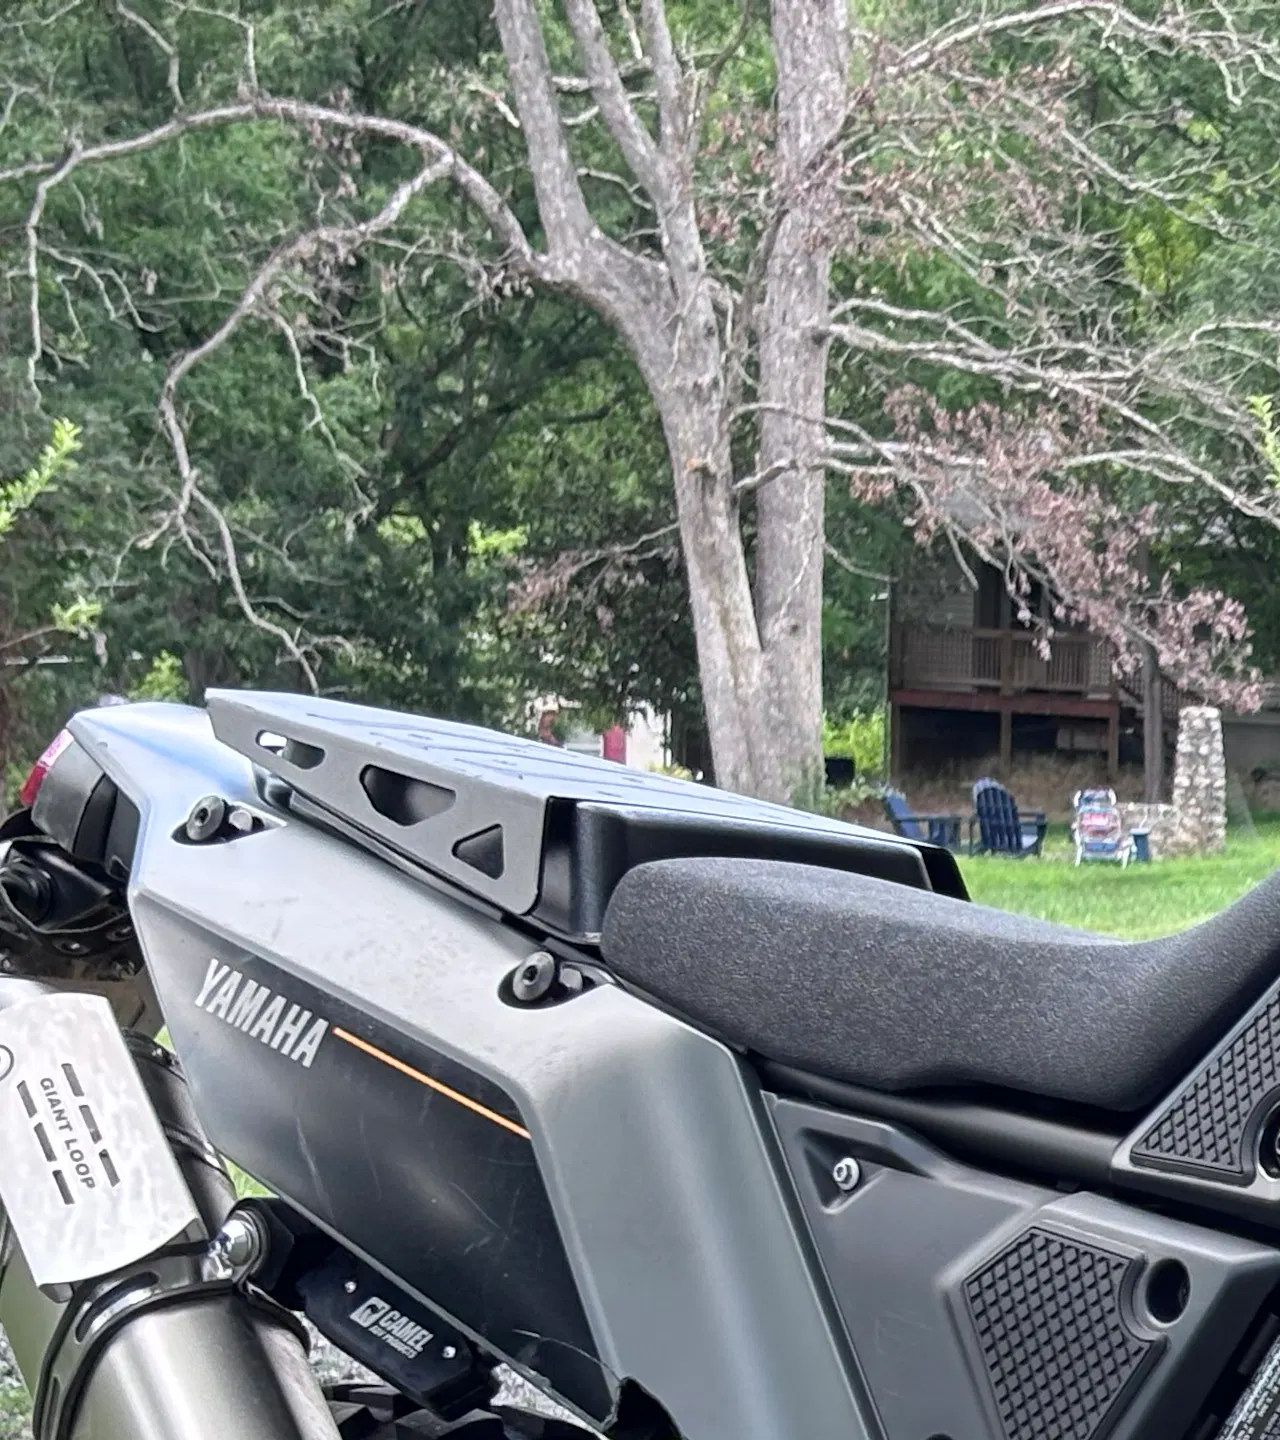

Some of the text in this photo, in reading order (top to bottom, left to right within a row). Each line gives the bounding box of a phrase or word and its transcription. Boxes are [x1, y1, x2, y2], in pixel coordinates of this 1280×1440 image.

[195, 958, 330, 1068] YAMAHA
[40, 1077, 96, 1189] GIANT LOOP
[379, 1310, 434, 1352] CAMEL
